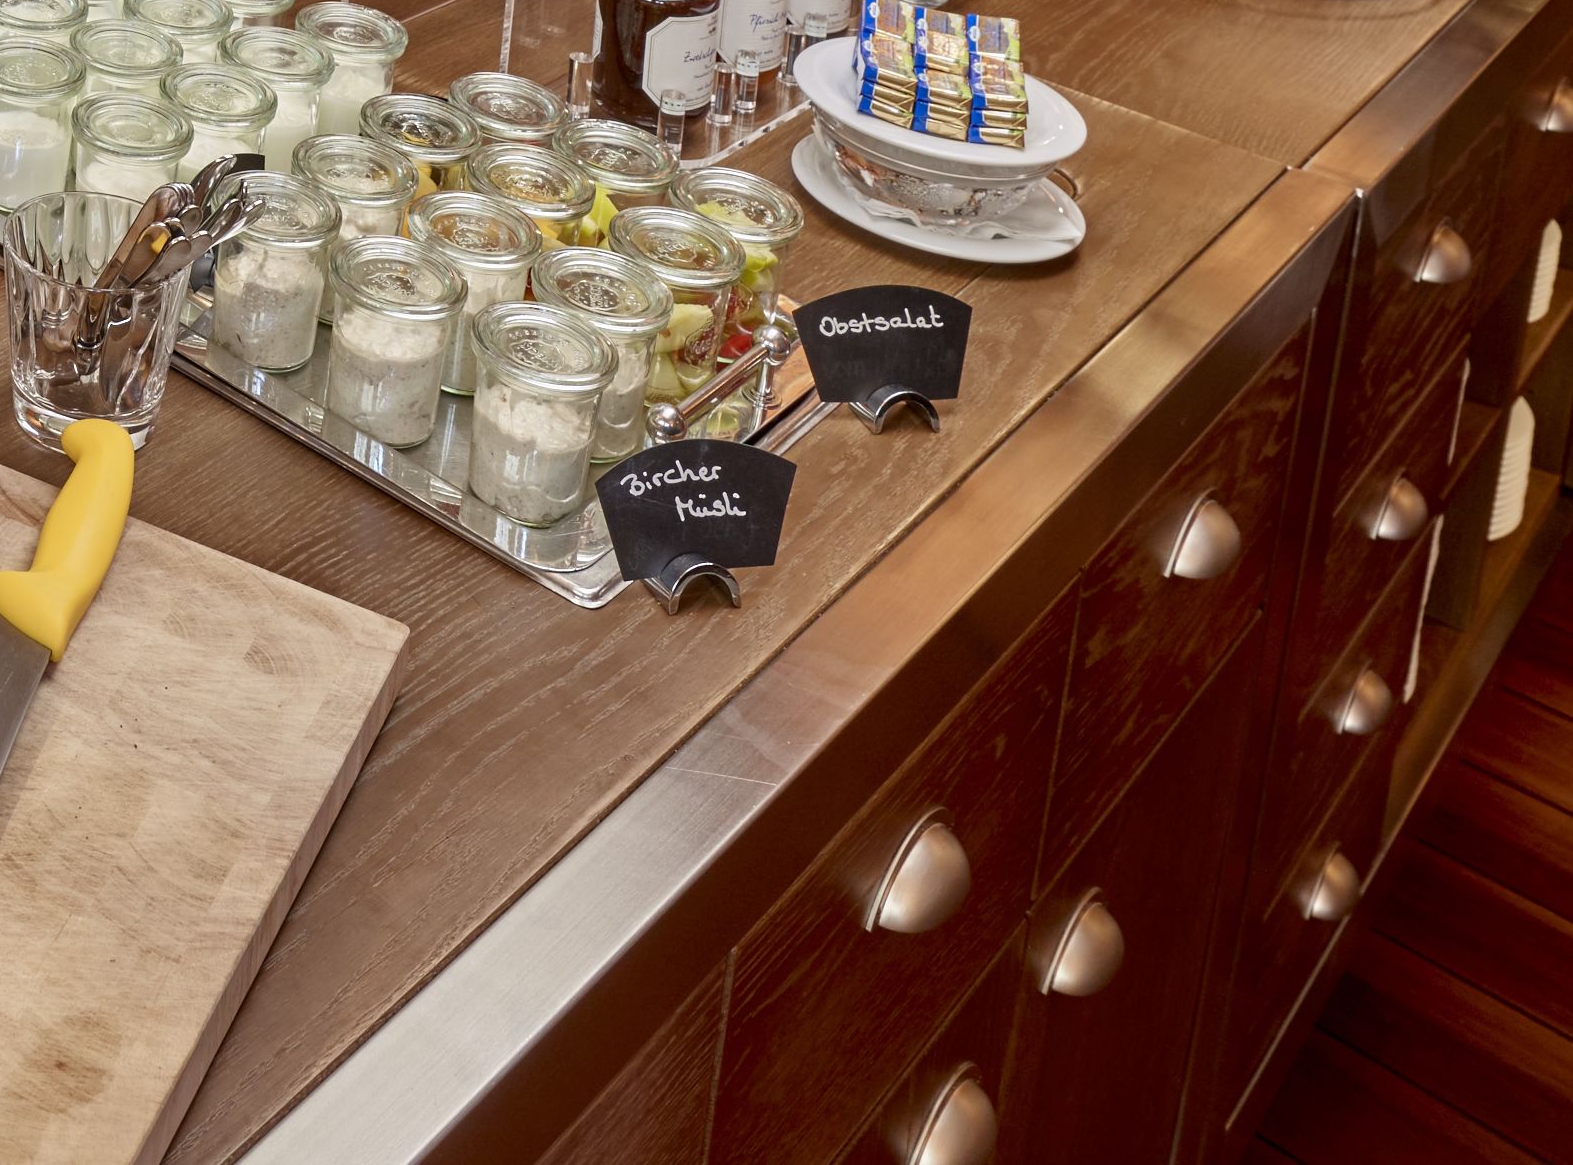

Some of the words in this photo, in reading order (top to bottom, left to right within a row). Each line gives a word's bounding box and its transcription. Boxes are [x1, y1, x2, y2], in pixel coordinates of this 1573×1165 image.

[819, 305, 945, 337] Obstsalat
[620, 460, 722, 496] Bircher
[675, 491, 747, 522] Müsli
